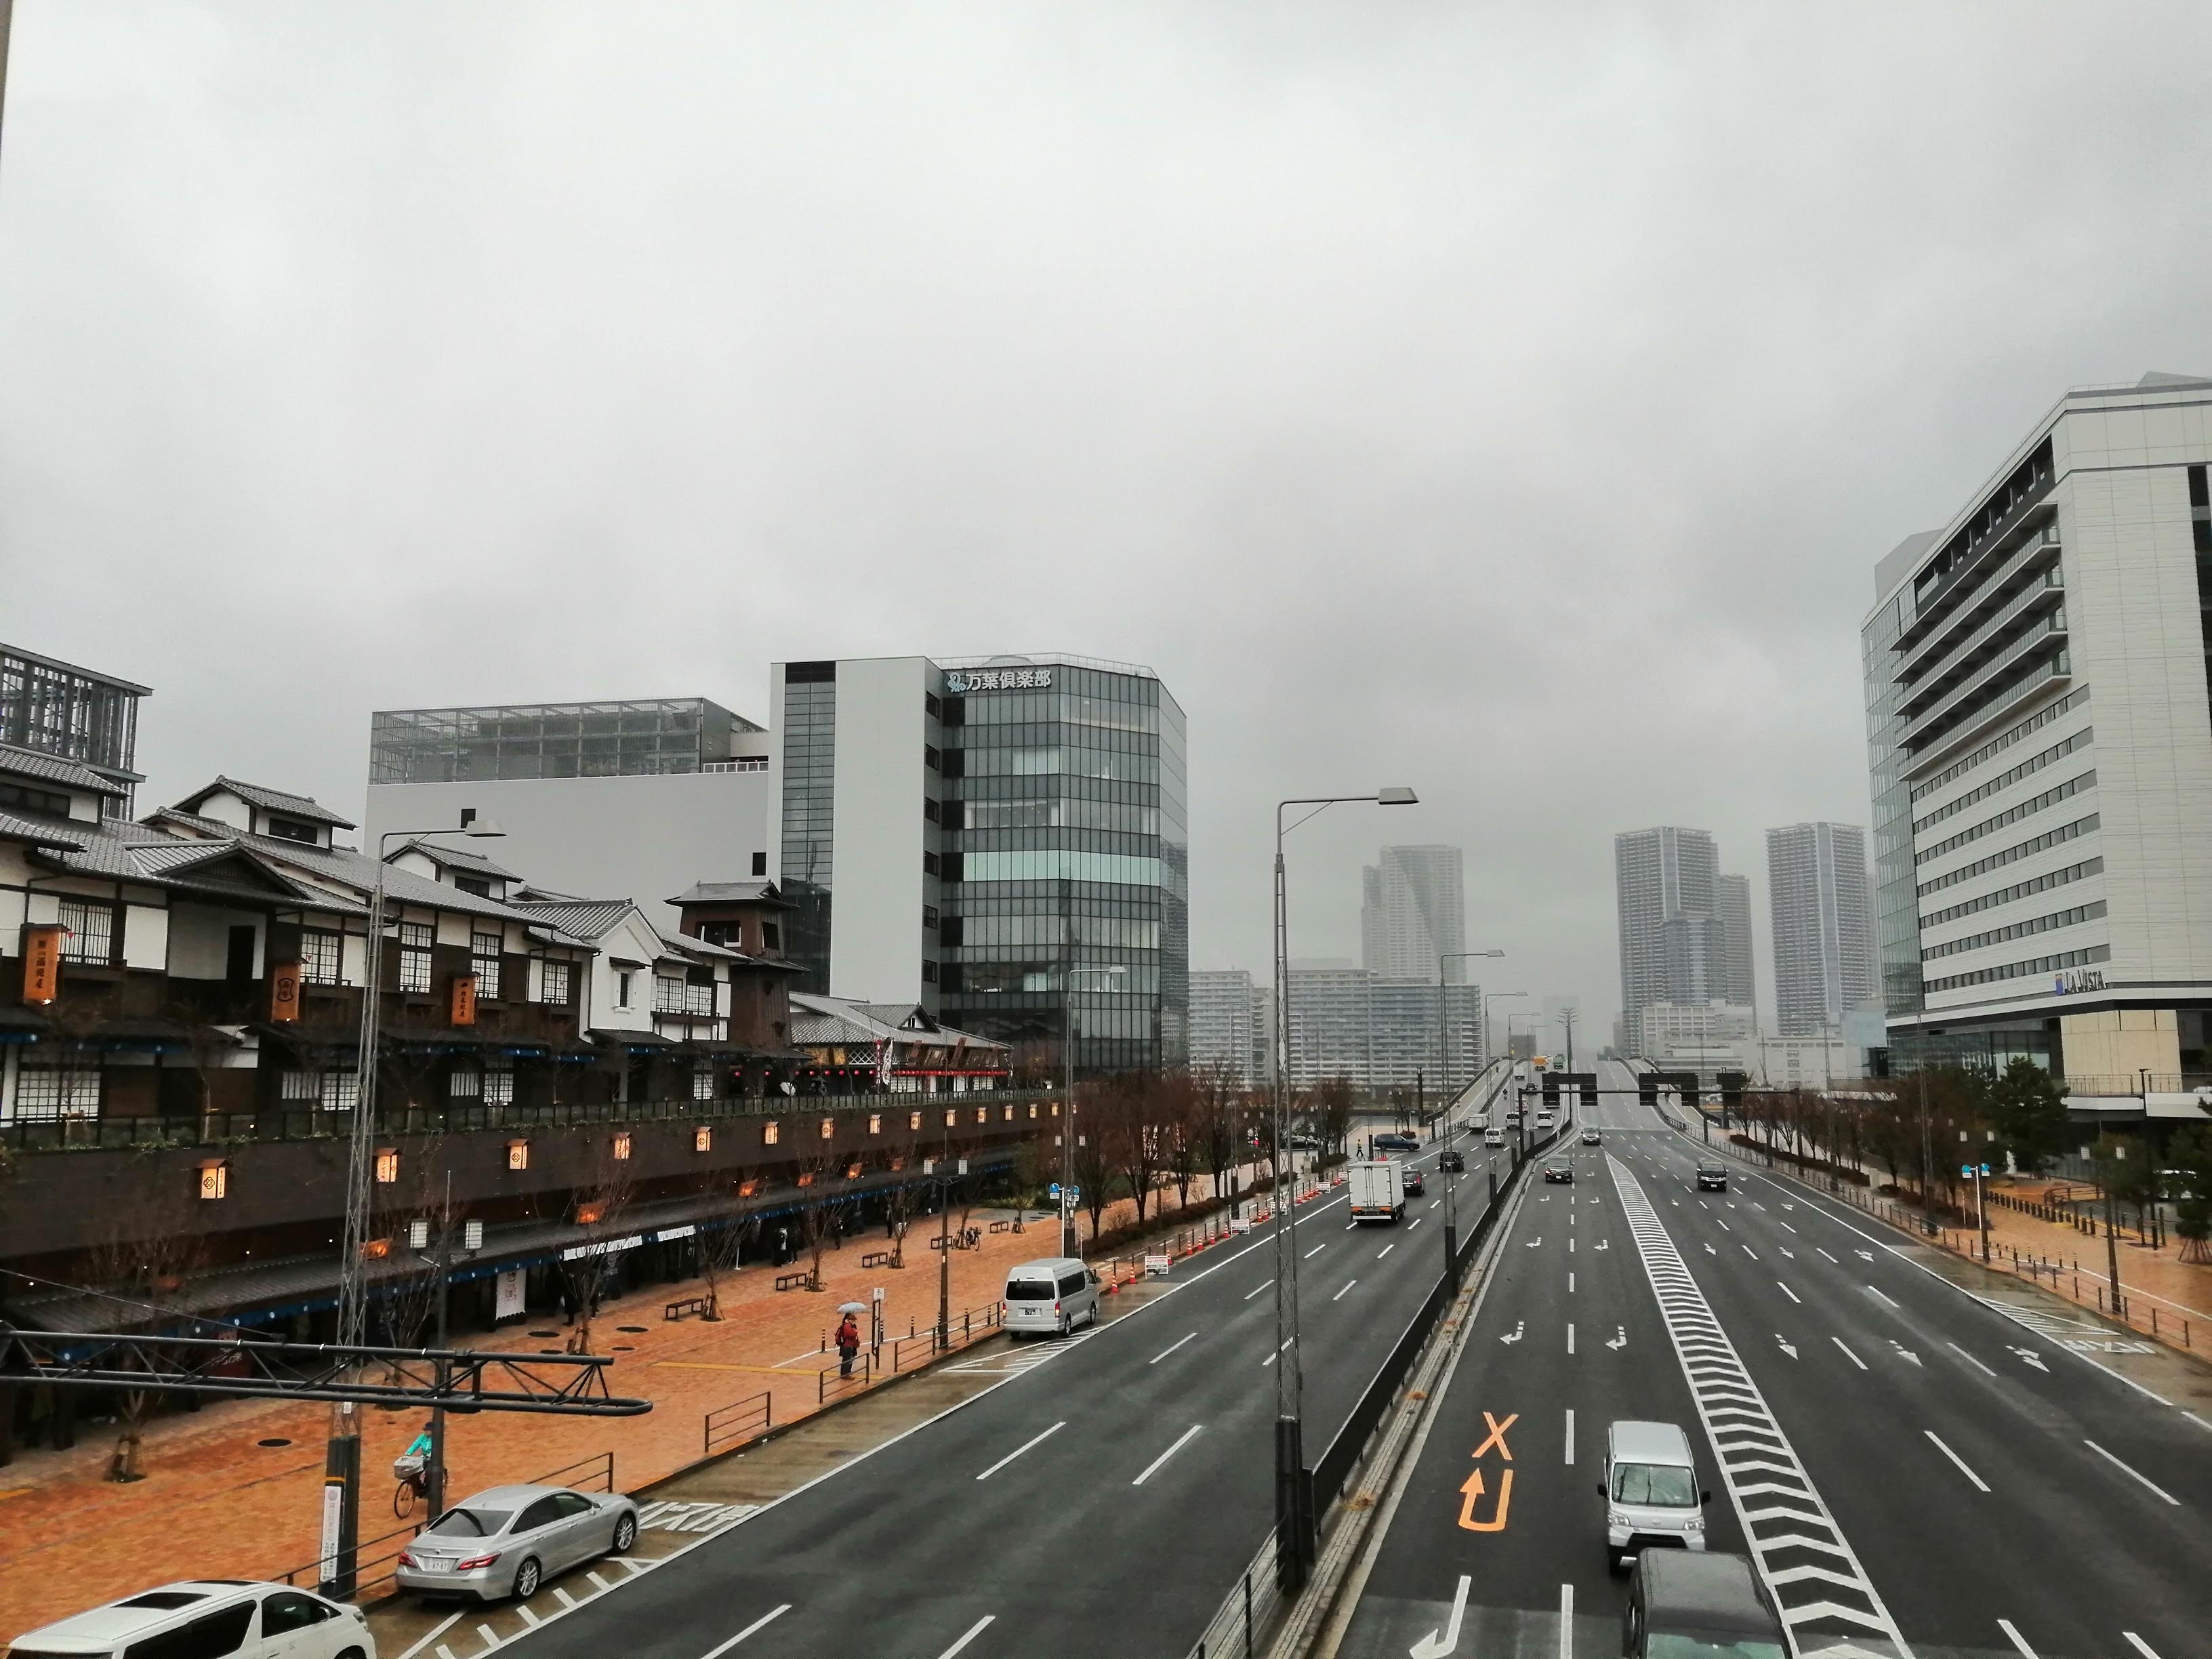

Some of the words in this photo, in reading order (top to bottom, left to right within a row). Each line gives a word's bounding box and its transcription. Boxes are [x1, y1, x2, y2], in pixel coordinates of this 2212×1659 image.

[965, 670, 1052, 691] 万葉倶楽部
[2077, 968, 2107, 992] VISTA
